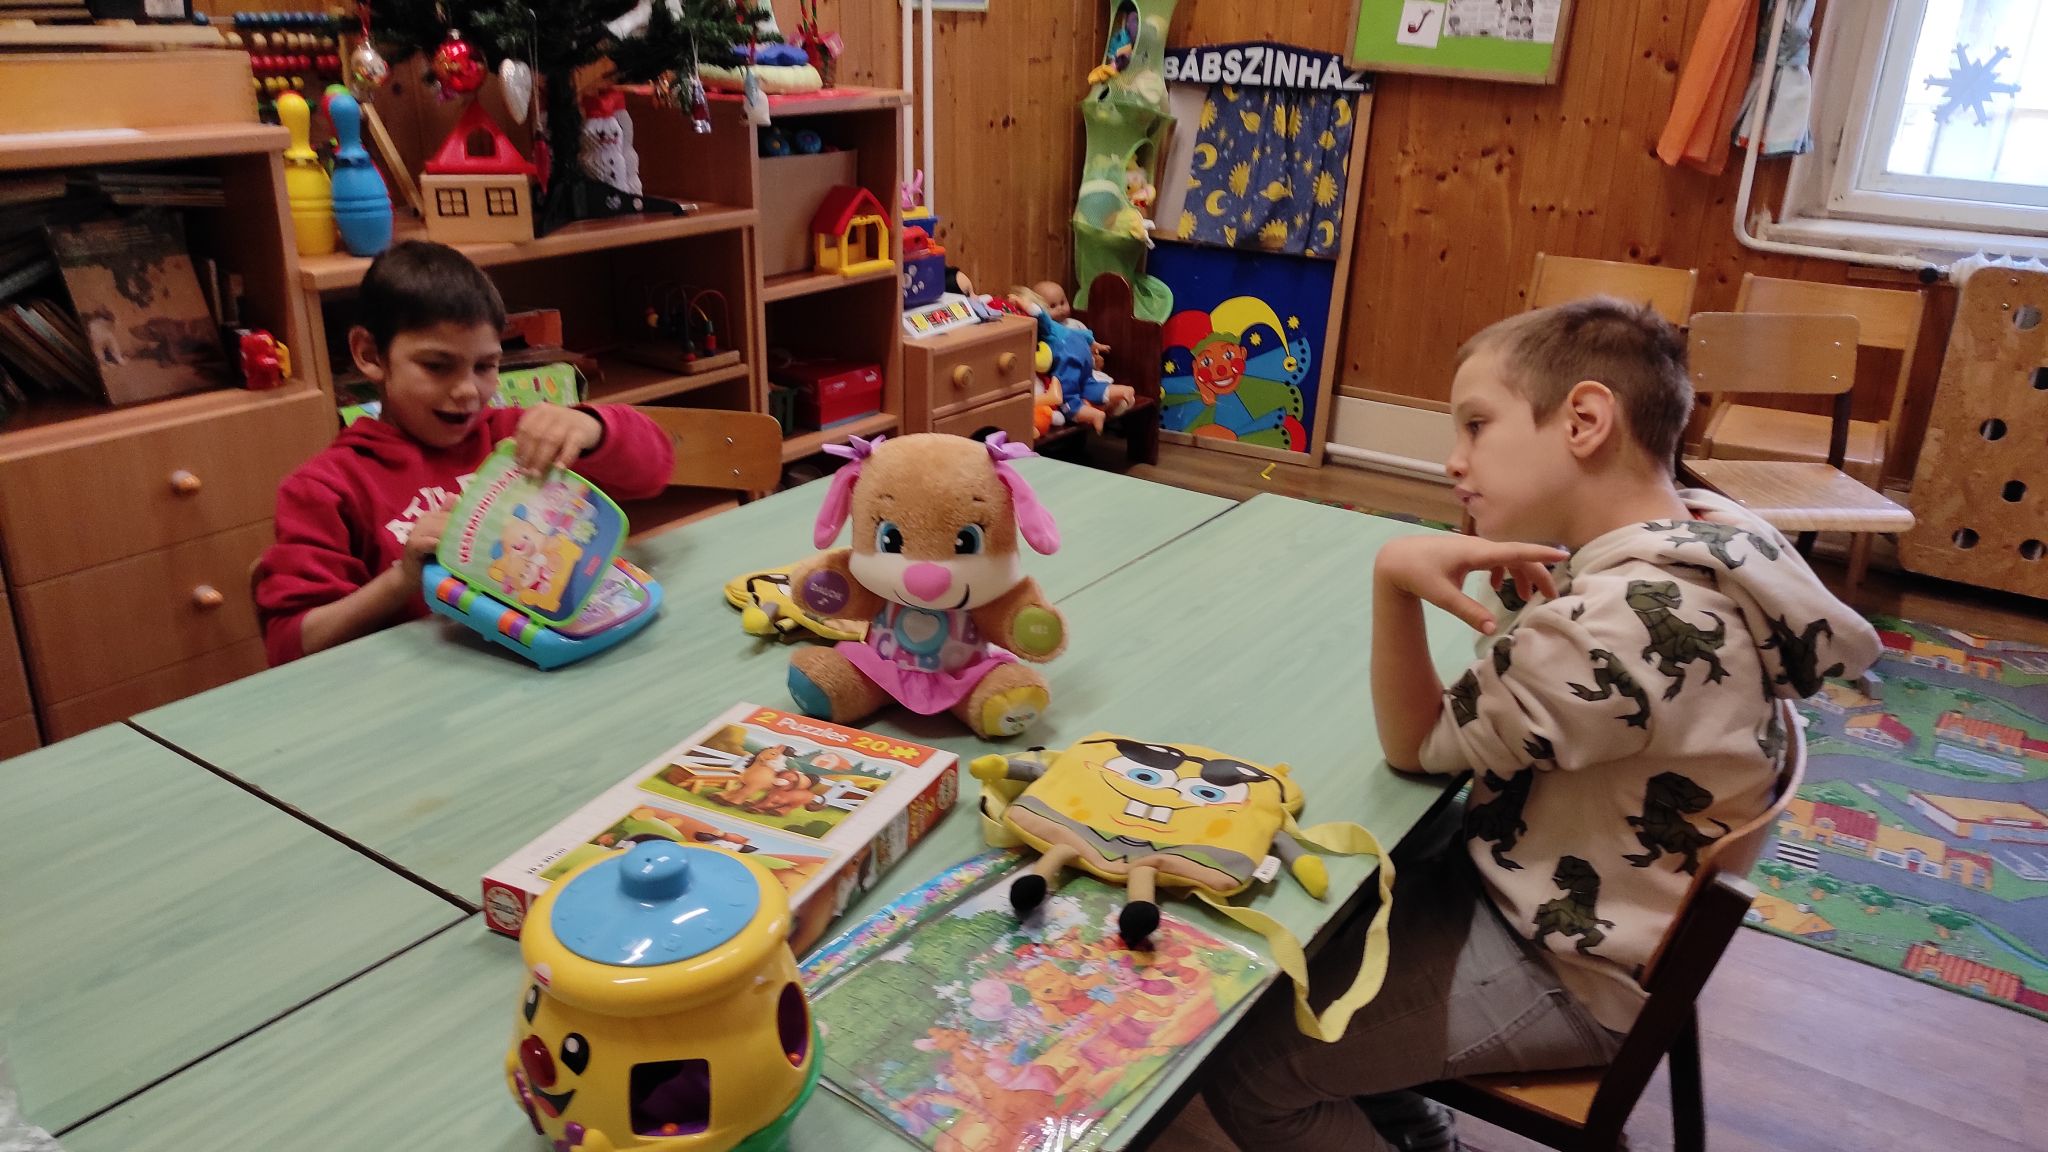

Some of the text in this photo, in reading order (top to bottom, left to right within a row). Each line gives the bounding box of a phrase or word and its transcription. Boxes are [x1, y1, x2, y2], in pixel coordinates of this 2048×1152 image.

[754, 711, 890, 753] 2 Puzzles 20
